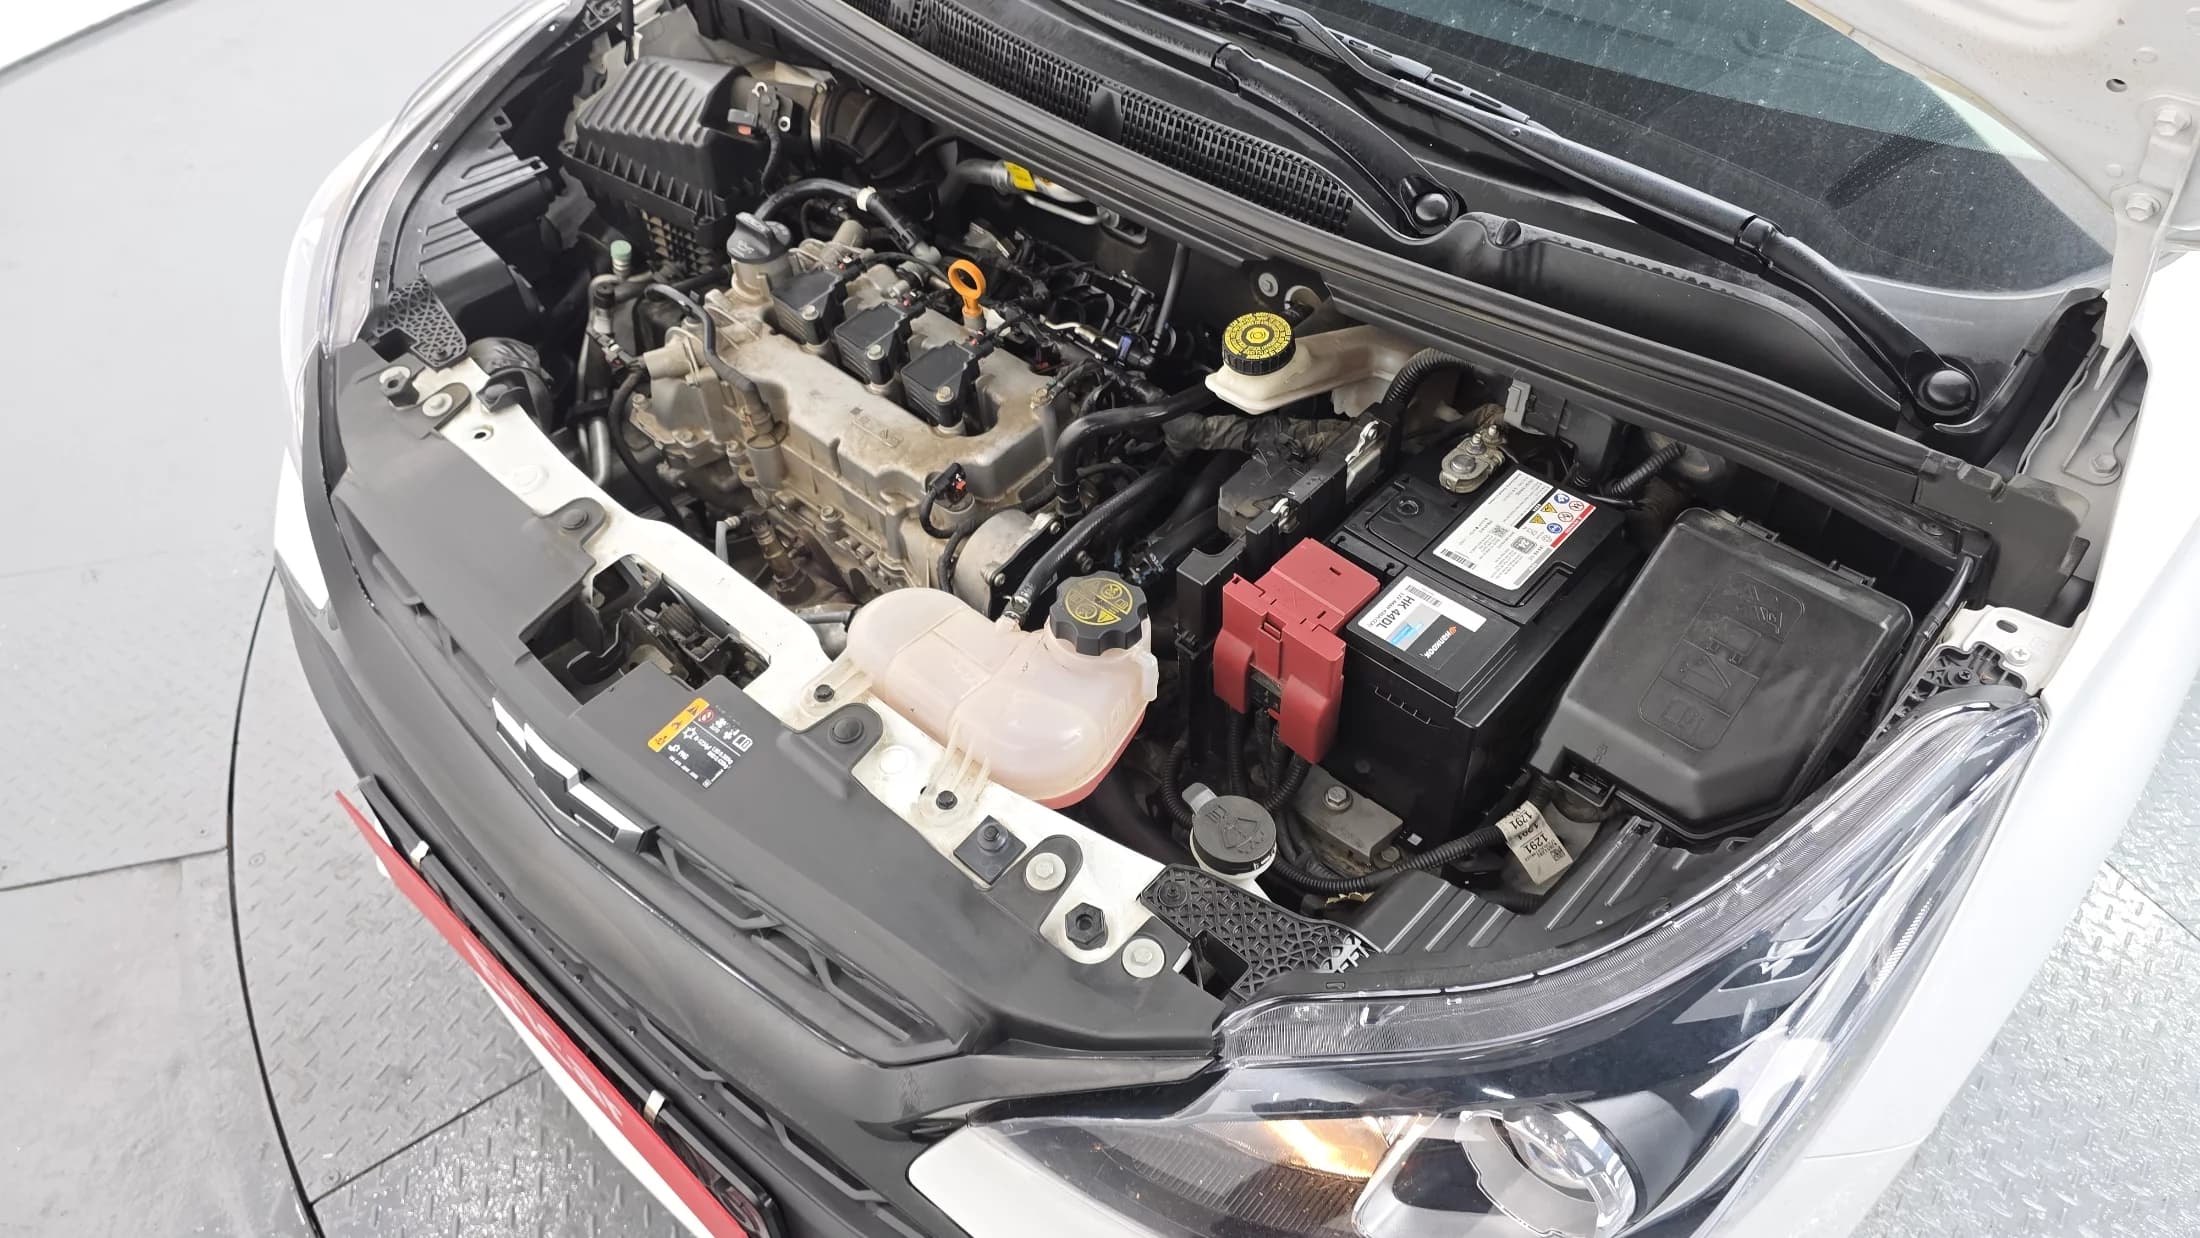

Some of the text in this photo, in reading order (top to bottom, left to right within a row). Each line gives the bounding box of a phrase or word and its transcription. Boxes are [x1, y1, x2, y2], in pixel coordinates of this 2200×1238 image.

[1375, 595, 1415, 629] HK 44DL
[1510, 811, 1532, 829] 1291
[1524, 833, 1548, 853] 1291
